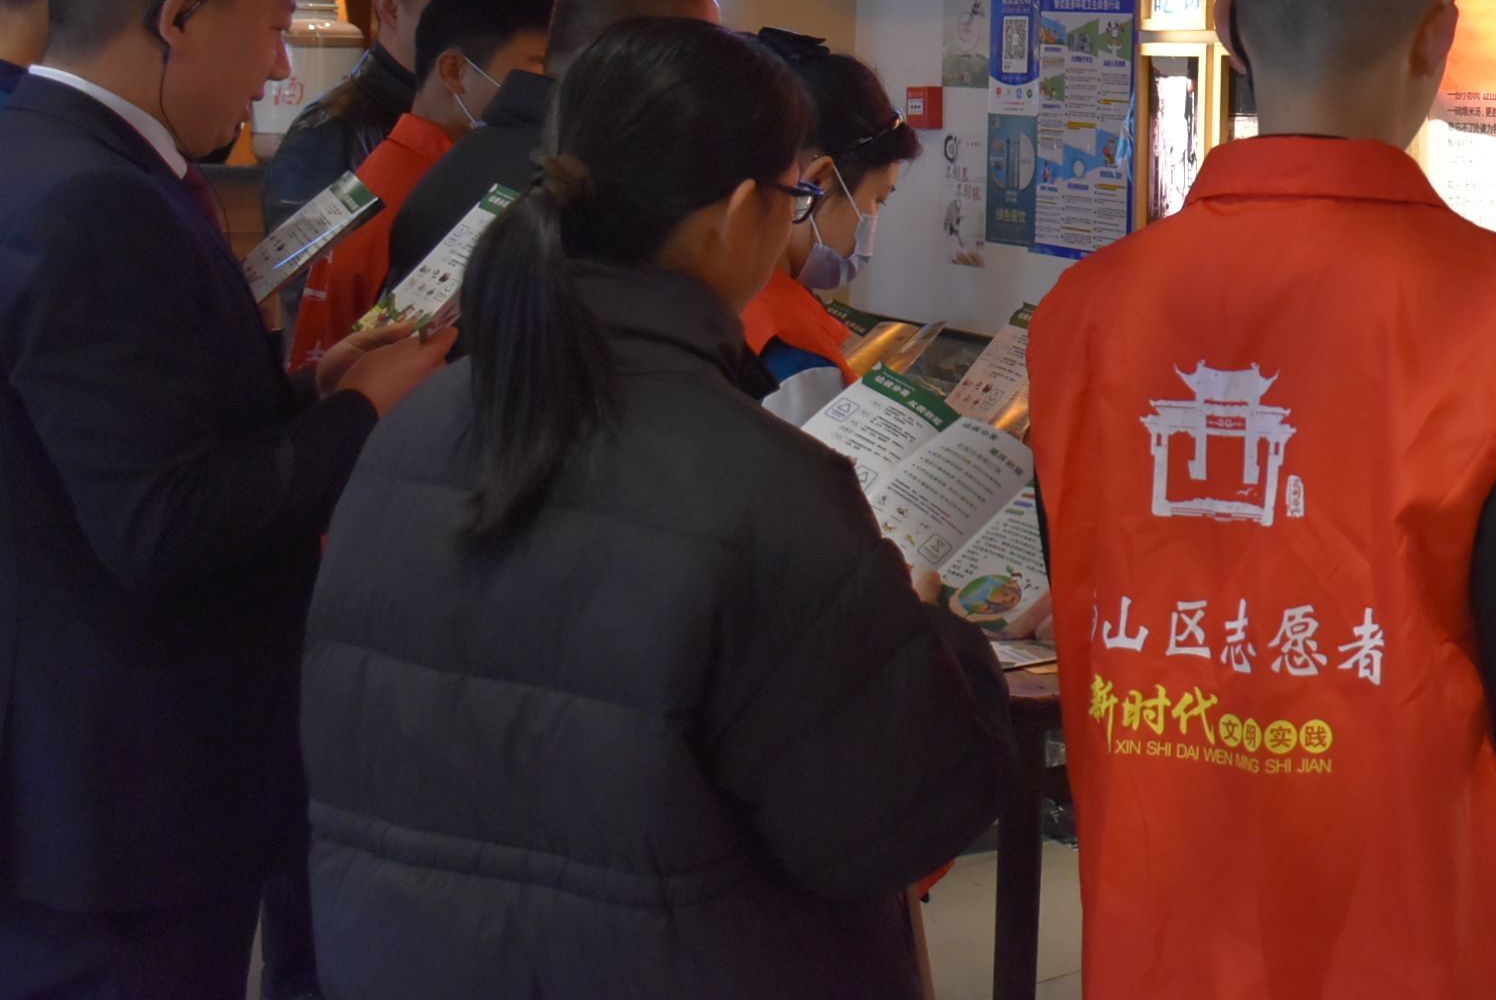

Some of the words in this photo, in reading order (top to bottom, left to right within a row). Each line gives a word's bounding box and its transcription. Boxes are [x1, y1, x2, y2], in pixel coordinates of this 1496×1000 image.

[1091, 595, 1385, 687] 山区志愿者
[1114, 739, 1142, 755] XIN
[1146, 741, 1172, 757] SHI
[1176, 743, 1200, 760] DAI
[1203, 746, 1233, 767] WEN
[1265, 757, 1292, 773] SHI
[1297, 758, 1332, 774] JIAN
